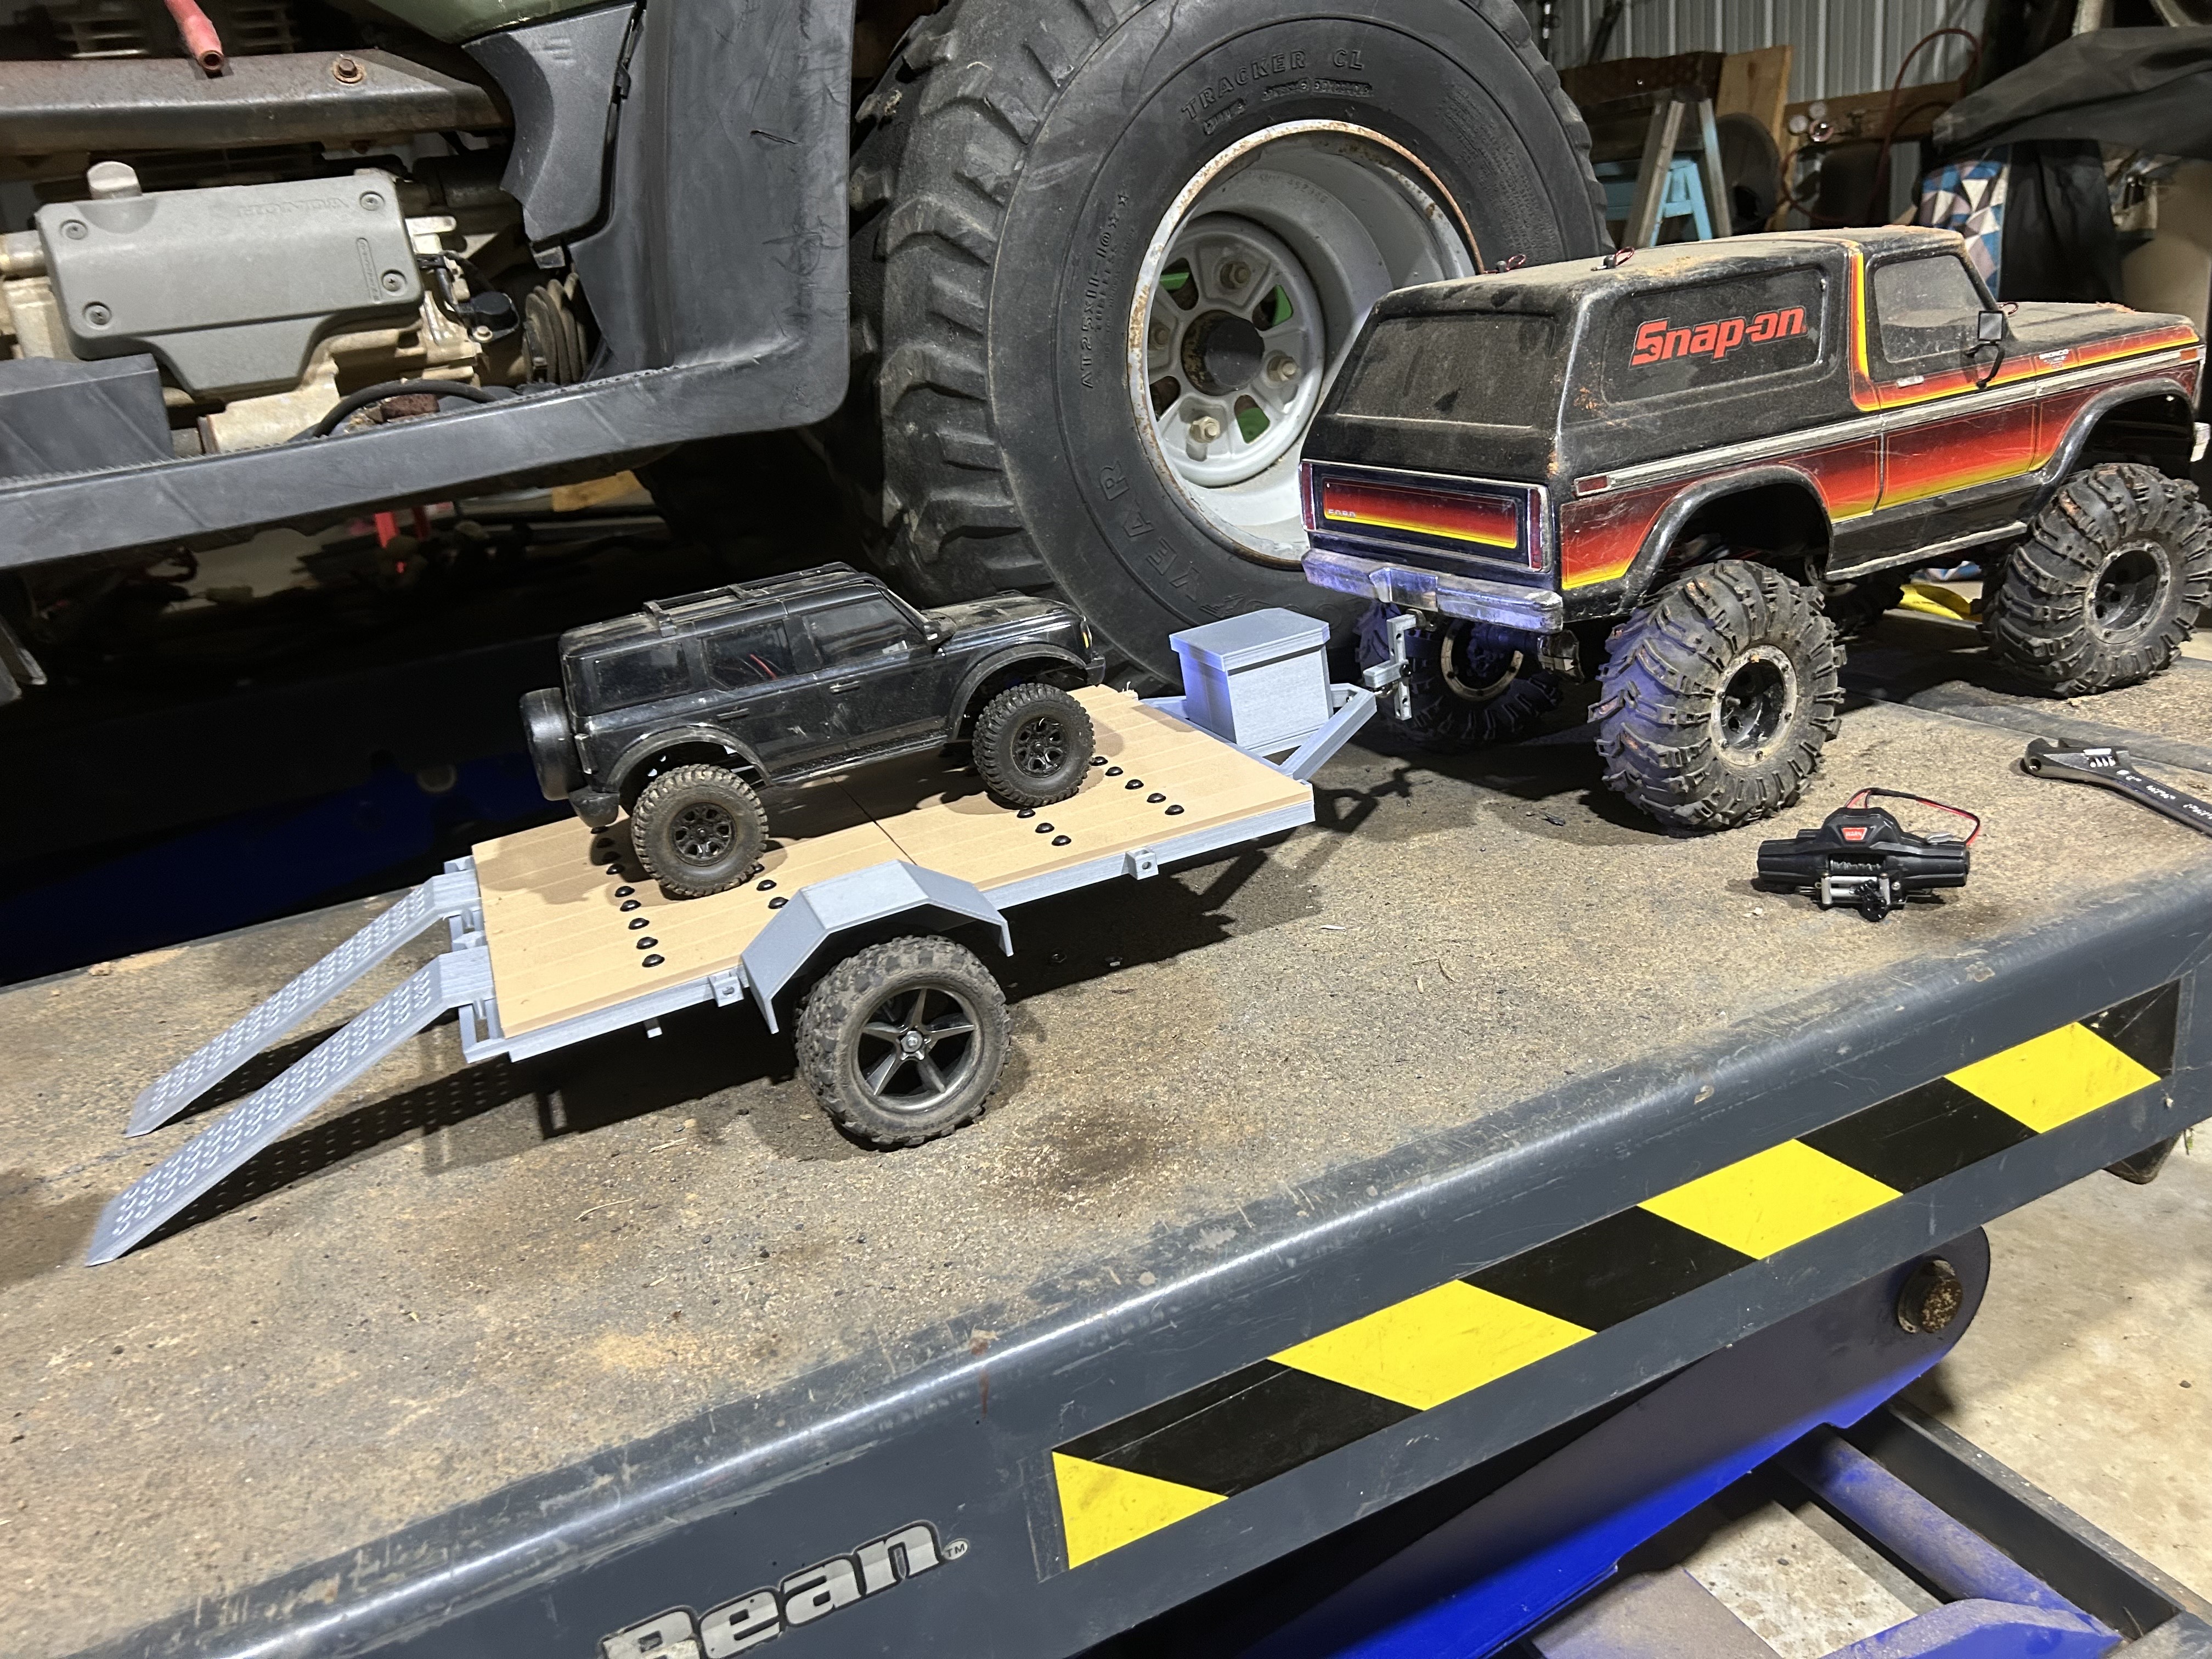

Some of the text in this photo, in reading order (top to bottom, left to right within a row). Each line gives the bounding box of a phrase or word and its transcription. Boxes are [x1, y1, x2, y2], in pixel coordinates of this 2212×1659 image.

[1181, 49, 1306, 120] TRACKER
[1333, 49, 1365, 70] CL
[1631, 307, 1804, 366] Snap-on
